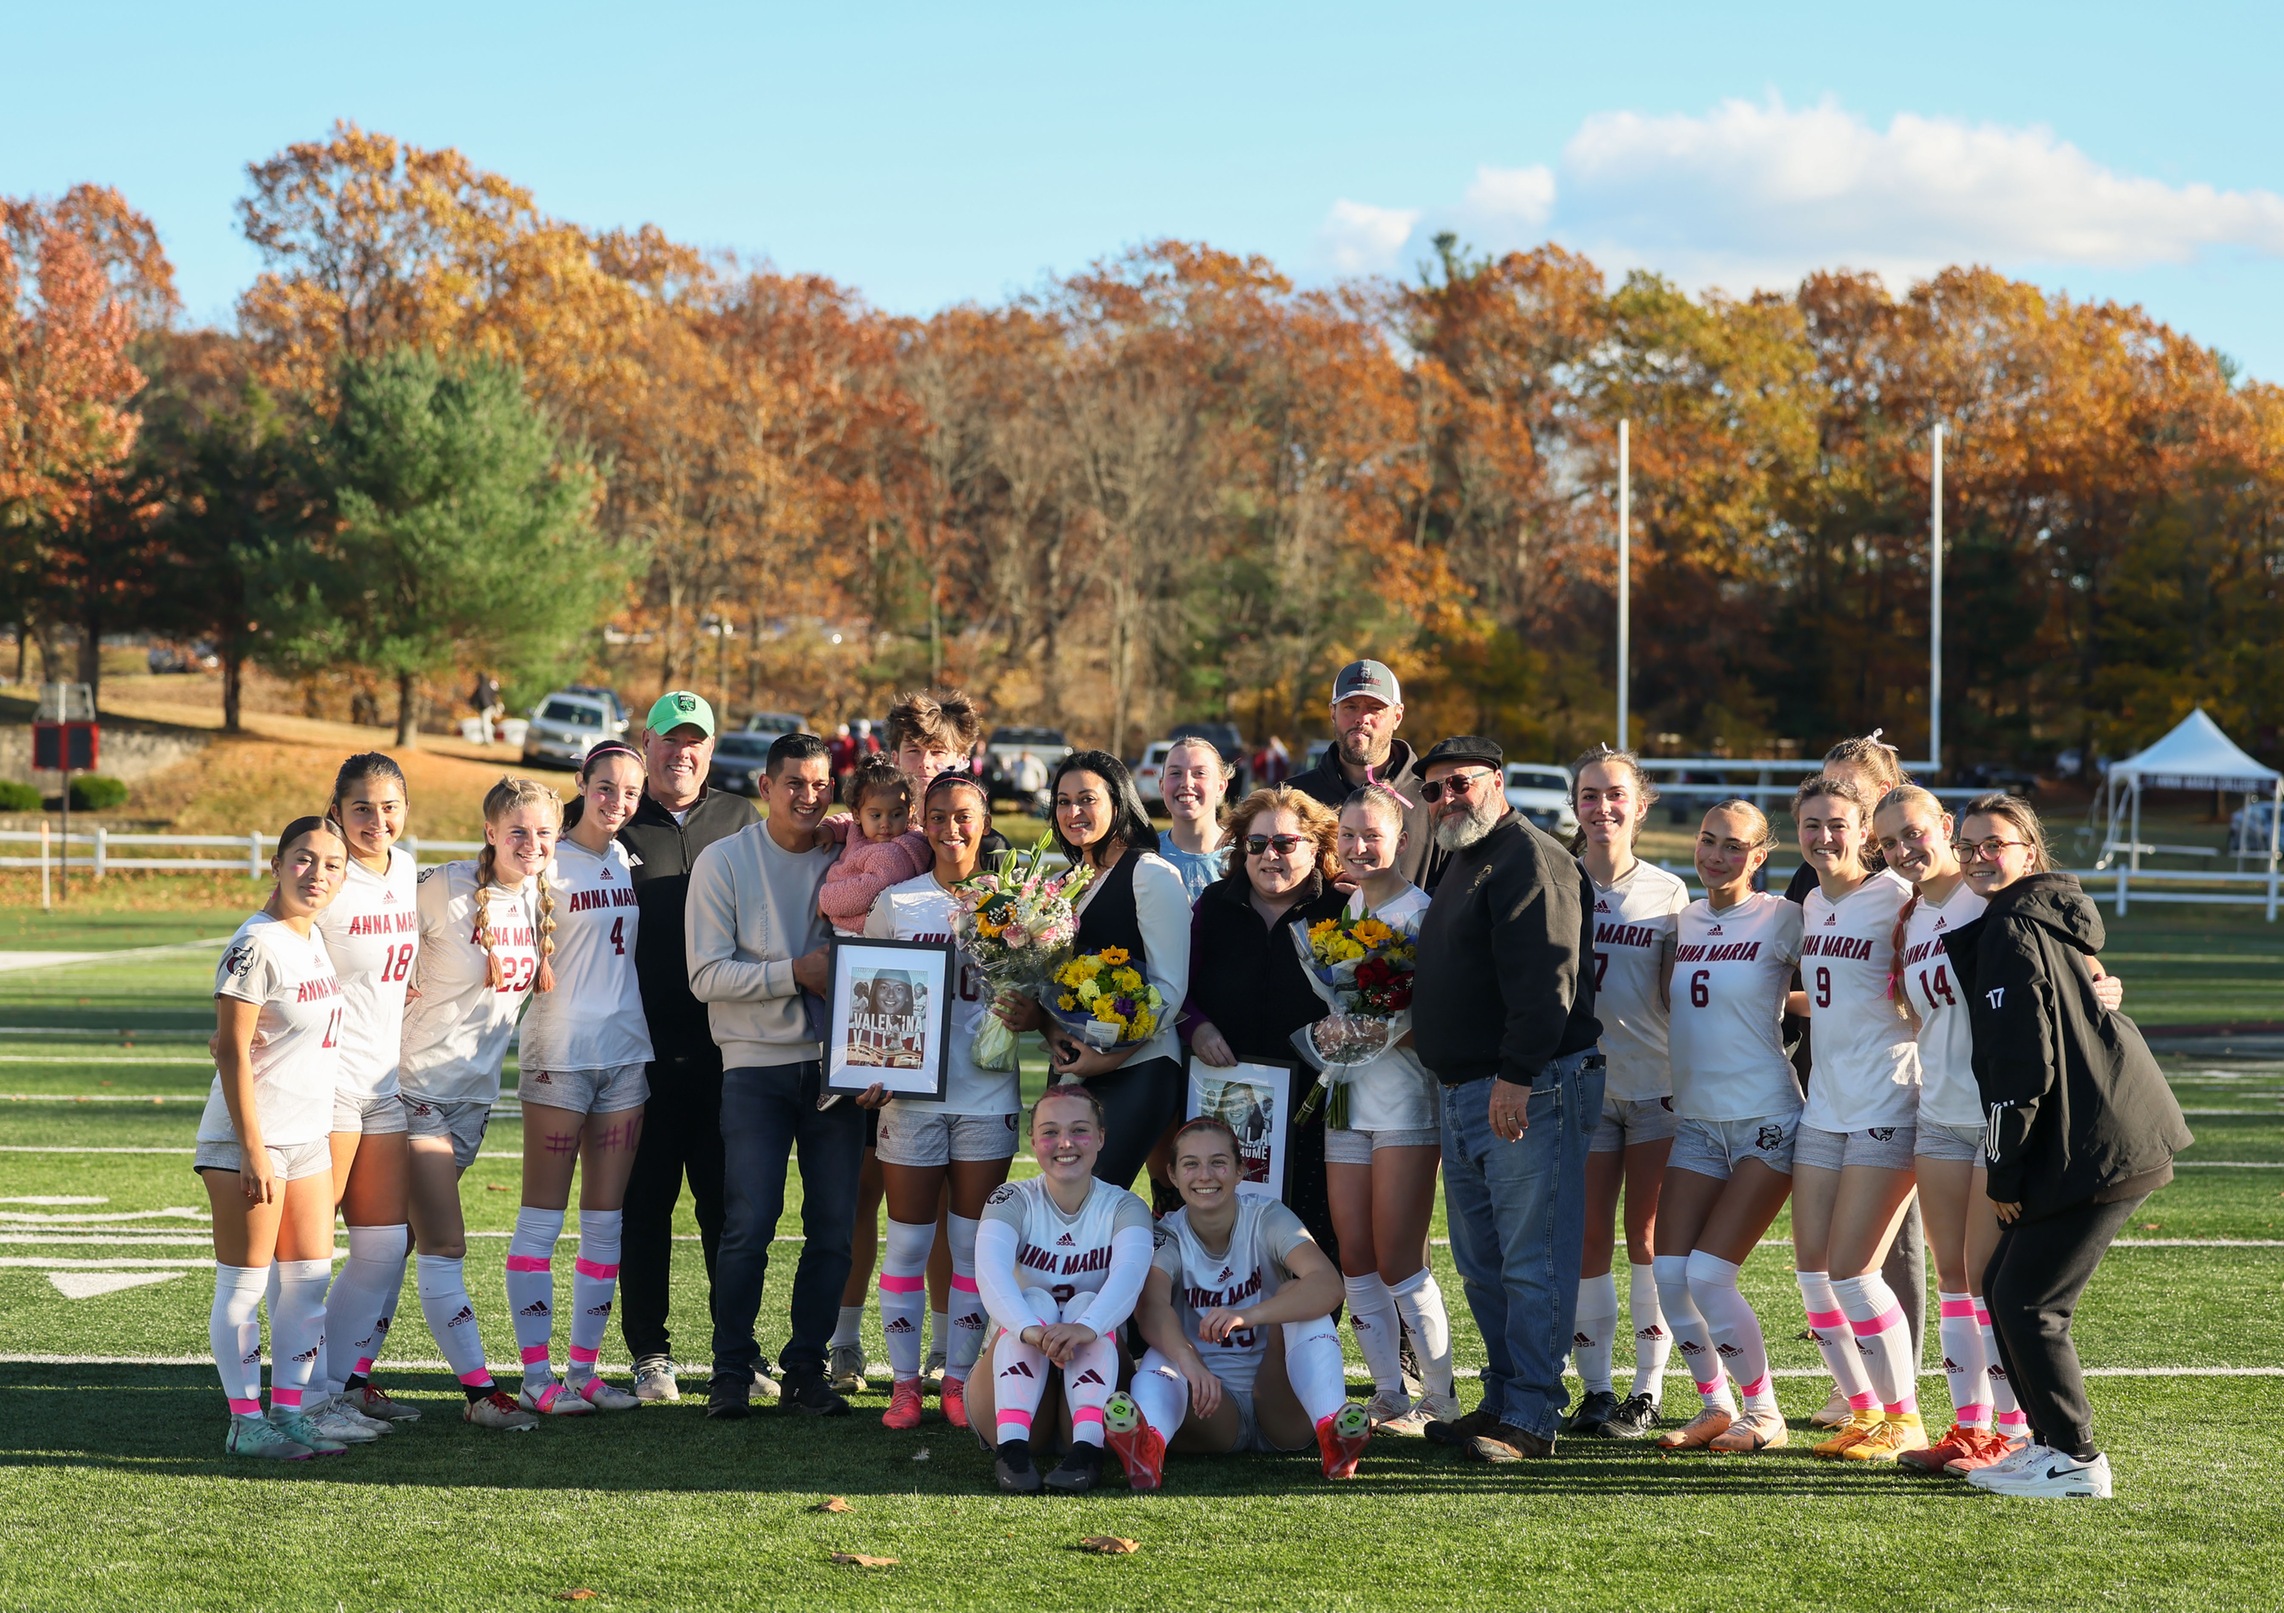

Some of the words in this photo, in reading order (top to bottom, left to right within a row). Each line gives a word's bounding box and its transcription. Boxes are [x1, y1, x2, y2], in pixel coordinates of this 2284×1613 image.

[569, 889, 610, 913] ANNA
[349, 914, 392, 935] ANNA
[610, 917, 625, 955] 4
[1594, 923, 1654, 947] MARIA
[1704, 942, 1762, 961] MARIA
[1821, 935, 1874, 960] MARIA
[381, 944, 413, 982] 18
[496, 957, 534, 992] 23
[297, 978, 331, 1003] ANNA
[1690, 970, 1710, 1008] 6
[1816, 967, 1831, 1008] 9
[1919, 965, 1956, 1009] 14
[1986, 987, 2005, 1010] 17
[853, 1013, 923, 1032] VALENINA
[954, 1320, 985, 1330] adidas
